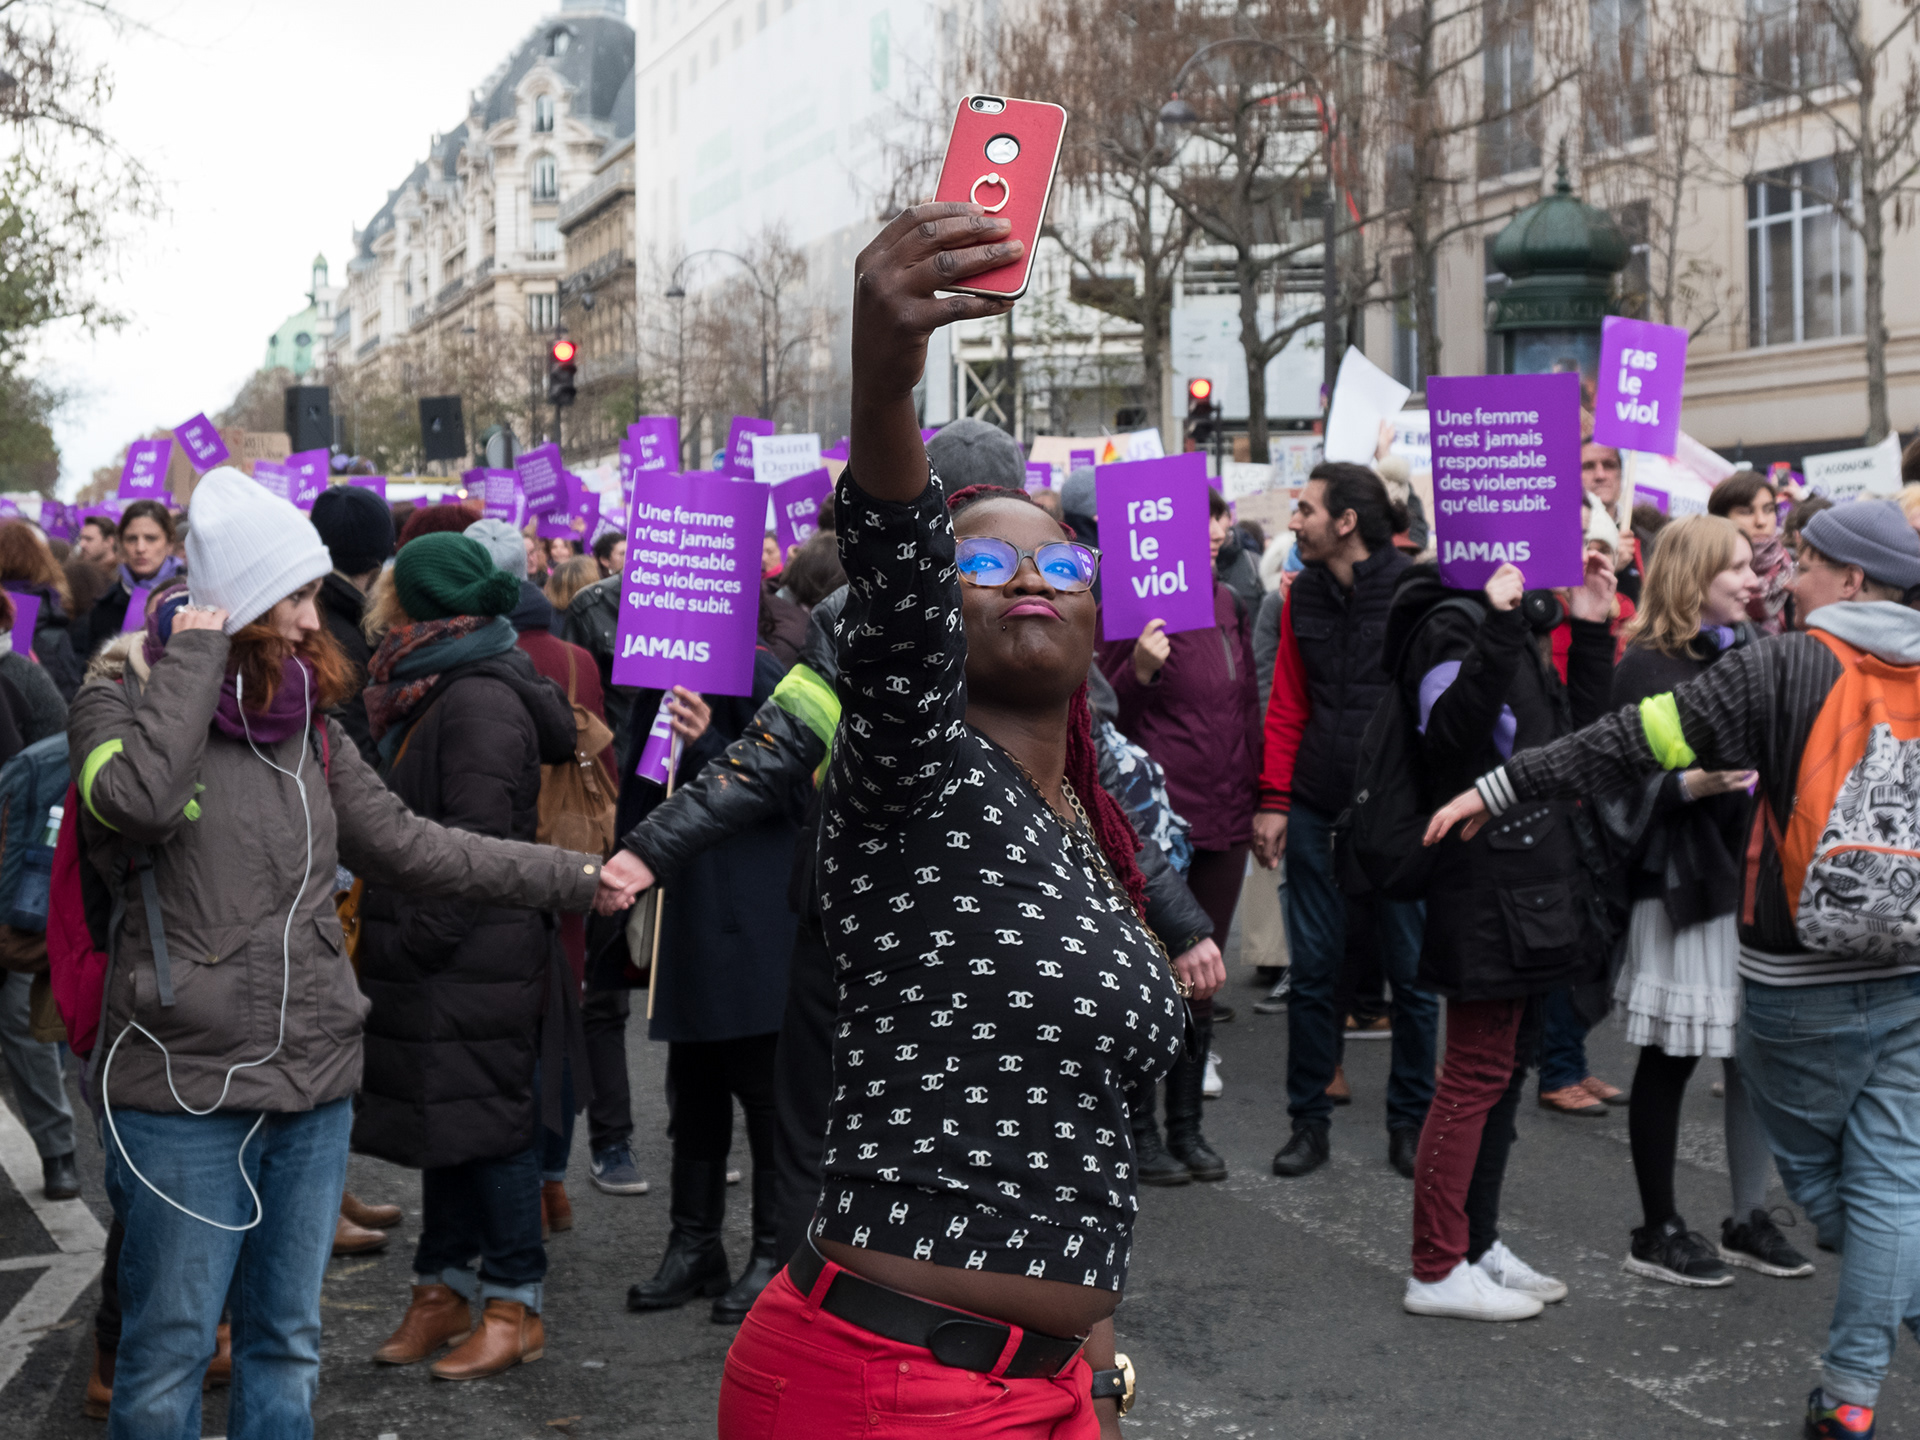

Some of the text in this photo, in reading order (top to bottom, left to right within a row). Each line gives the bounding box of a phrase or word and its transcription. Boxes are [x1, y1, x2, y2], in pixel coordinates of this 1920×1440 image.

[1621, 348, 1658, 371] ras
[1618, 367, 1642, 396] le
[1436, 407, 1539, 426] Une femme
[1615, 397, 1660, 427] viol
[762, 441, 811, 456] Saint
[1438, 429, 1543, 451] n'est jamais
[734, 455, 753, 469] vio
[762, 462, 816, 474] Denis
[1438, 450, 1547, 473] responsable
[1440, 473, 1557, 491] des violences
[638, 502, 671, 523] Une
[674, 505, 735, 528] femme
[786, 497, 817, 519] ras
[1127, 497, 1174, 525] ras
[1441, 494, 1551, 516] qu'elle subit.
[548, 513, 570, 526] viol
[635, 525, 676, 545] n'est
[679, 528, 735, 550] jamais
[791, 521, 813, 542] le
[1129, 529, 1159, 562] le
[1443, 540, 1531, 564] JAMAIS
[633, 549, 736, 572] responsable
[630, 566, 741, 594] des violences
[1131, 560, 1188, 598] viol
[628, 591, 733, 615] qu'elle subit.
[621, 634, 710, 663] JAMAIS
